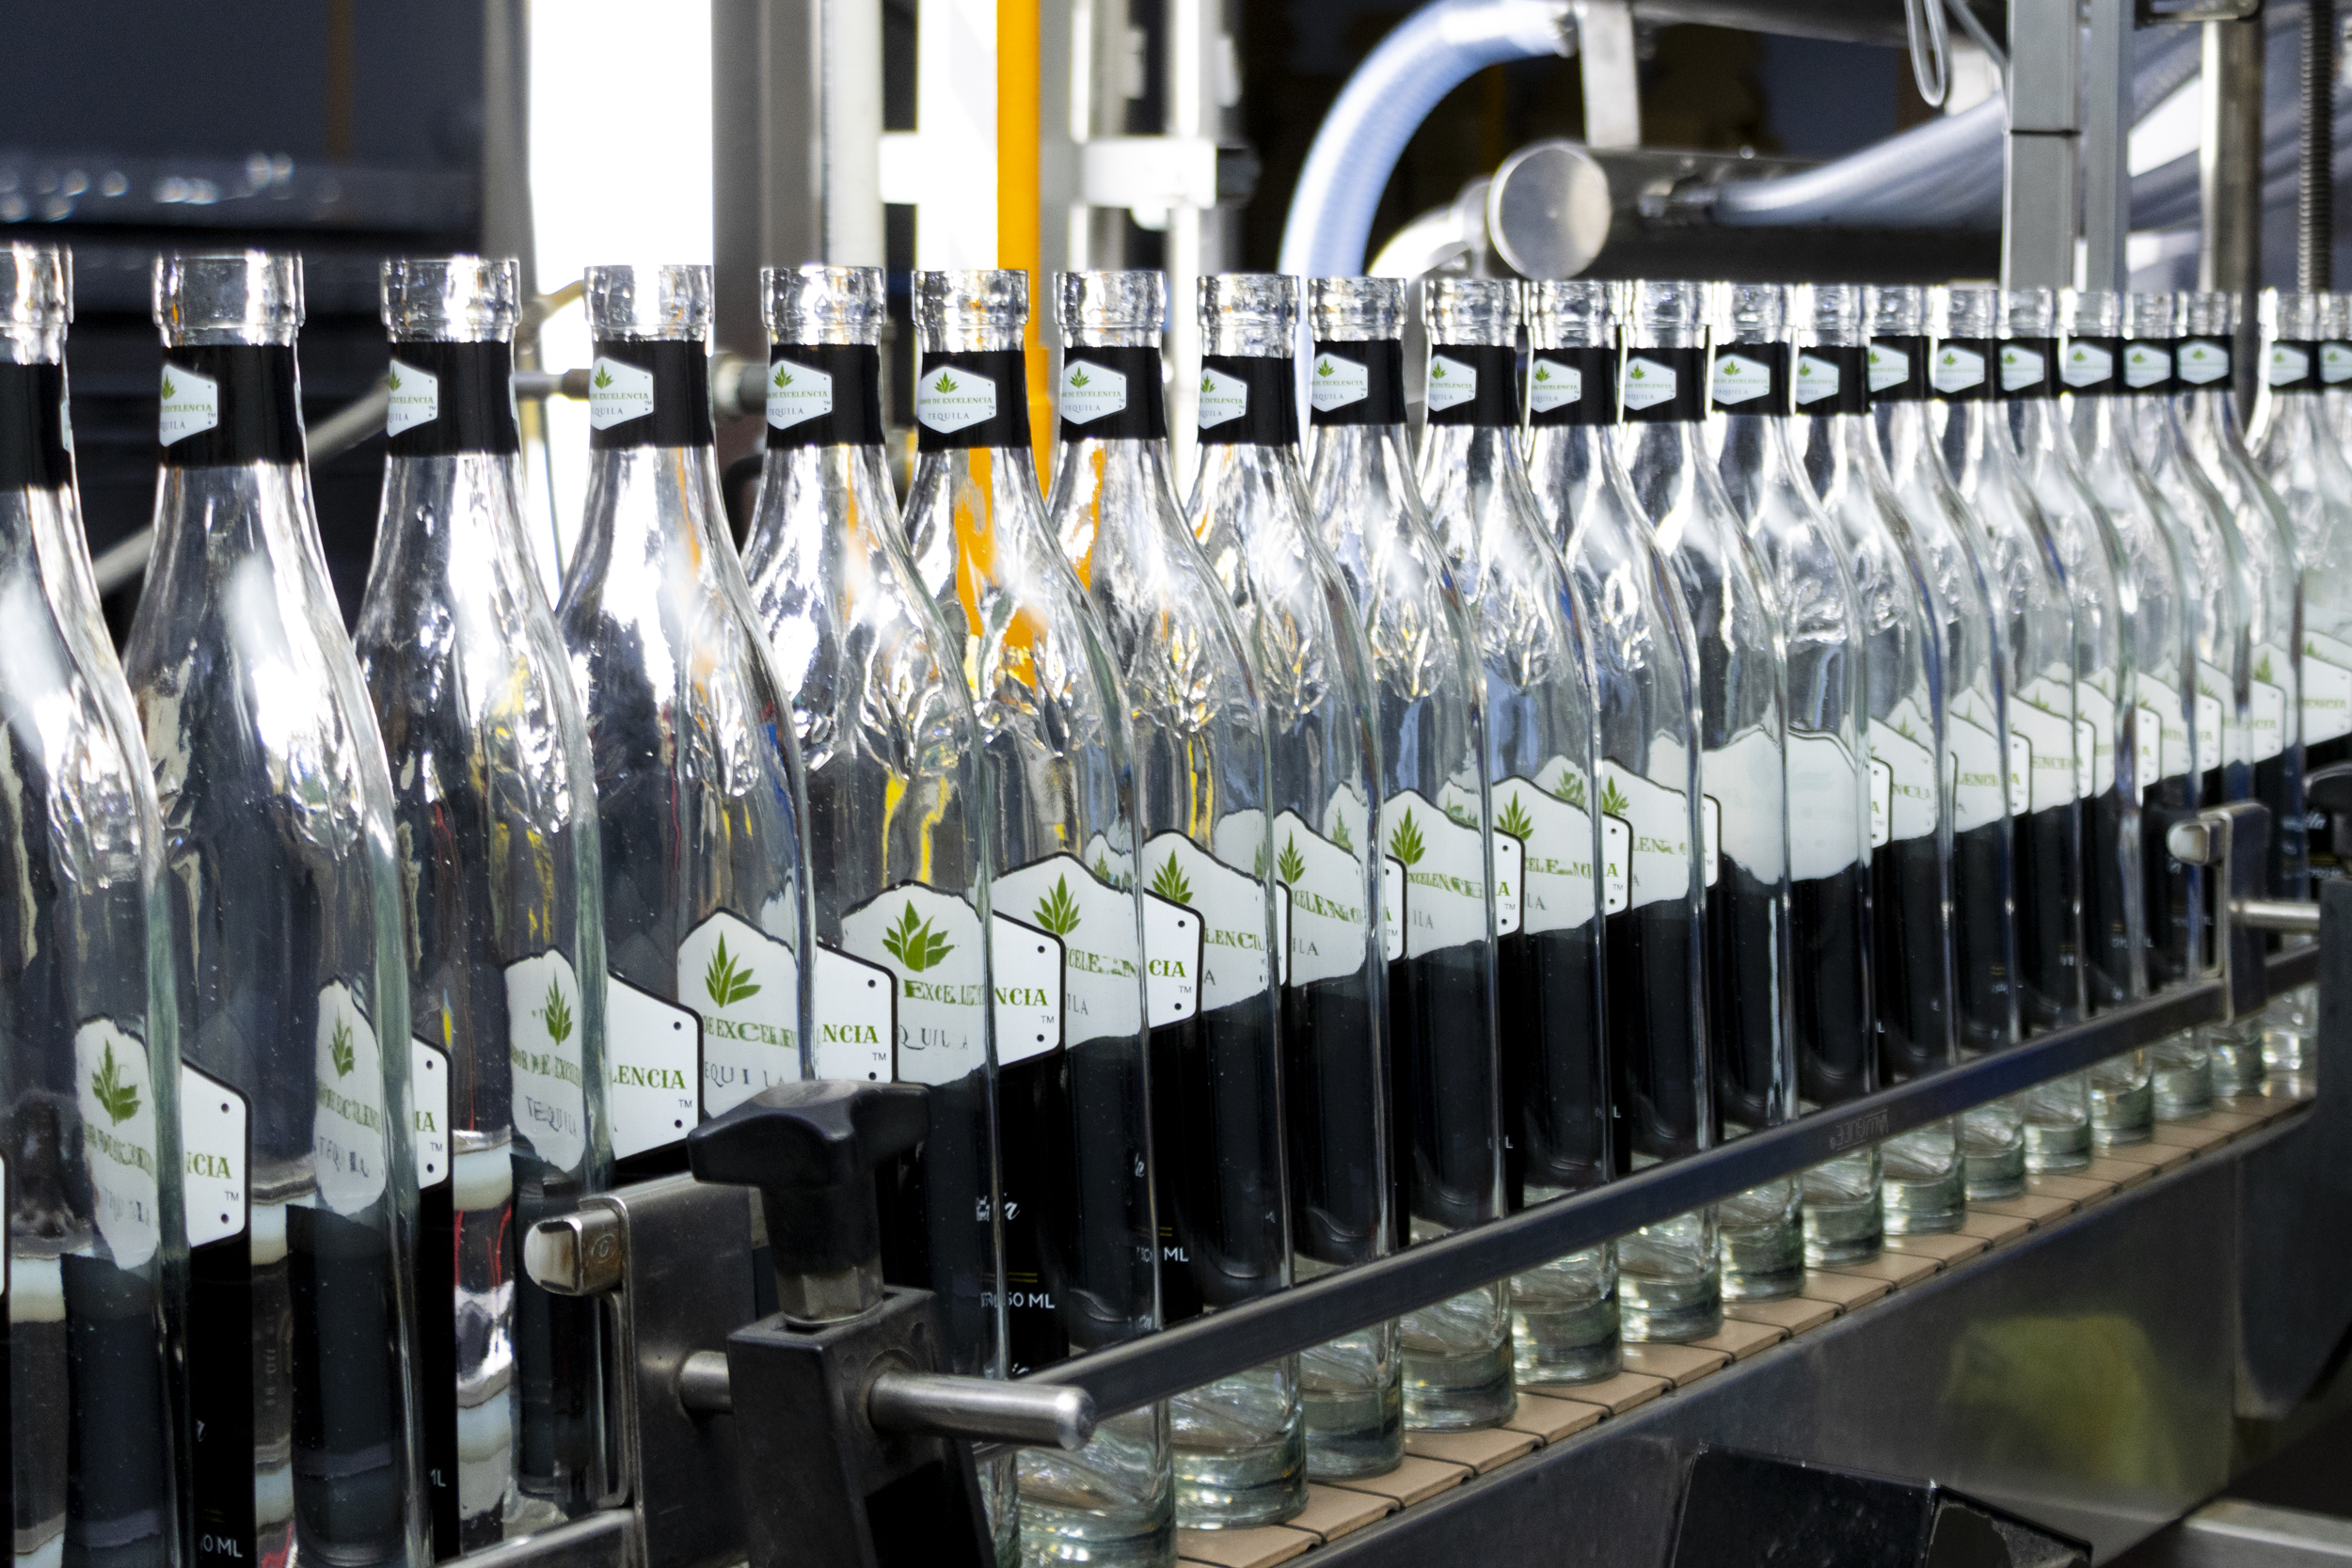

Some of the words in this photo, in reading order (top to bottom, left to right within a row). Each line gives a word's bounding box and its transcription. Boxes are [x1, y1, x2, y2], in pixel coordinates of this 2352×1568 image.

[1065, 404, 1101, 414] TEQUILA
[928, 412, 970, 421] TEQUILA
[872, 1053, 887, 1062] TM
[678, 1100, 692, 1109] TM
[430, 1142, 443, 1152] TM
[225, 1191, 240, 1202] TM
[1164, 1245, 1189, 1262] ML
[1028, 1291, 1056, 1308] ML
[217, 1536, 243, 1558] ML
